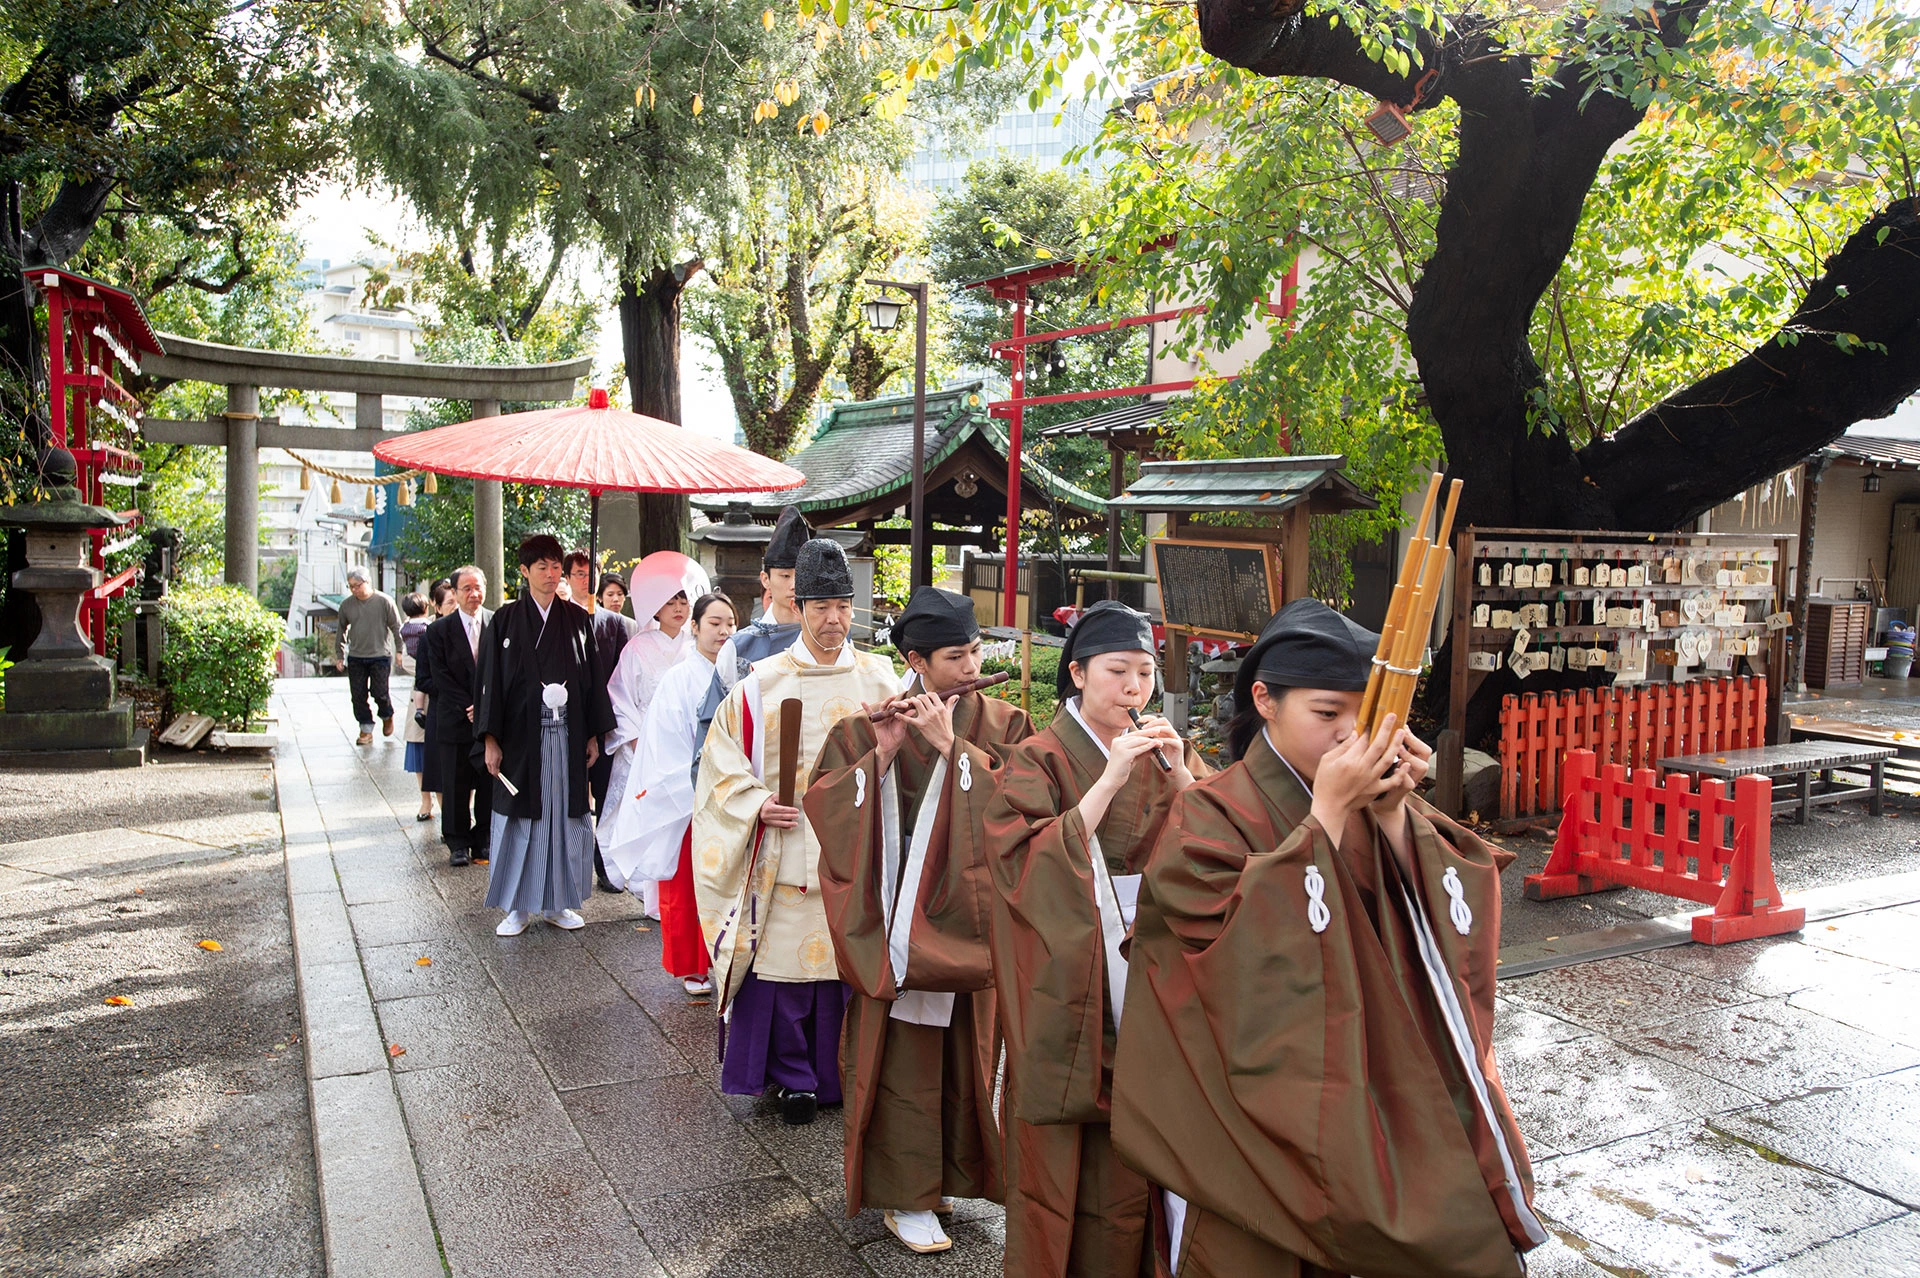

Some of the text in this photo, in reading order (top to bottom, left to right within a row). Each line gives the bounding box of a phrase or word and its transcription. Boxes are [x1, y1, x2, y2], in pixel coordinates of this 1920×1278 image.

[1771, 617, 1782, 625] 八
[1729, 642, 1738, 651] 八
[1589, 653, 1598, 661] 八
